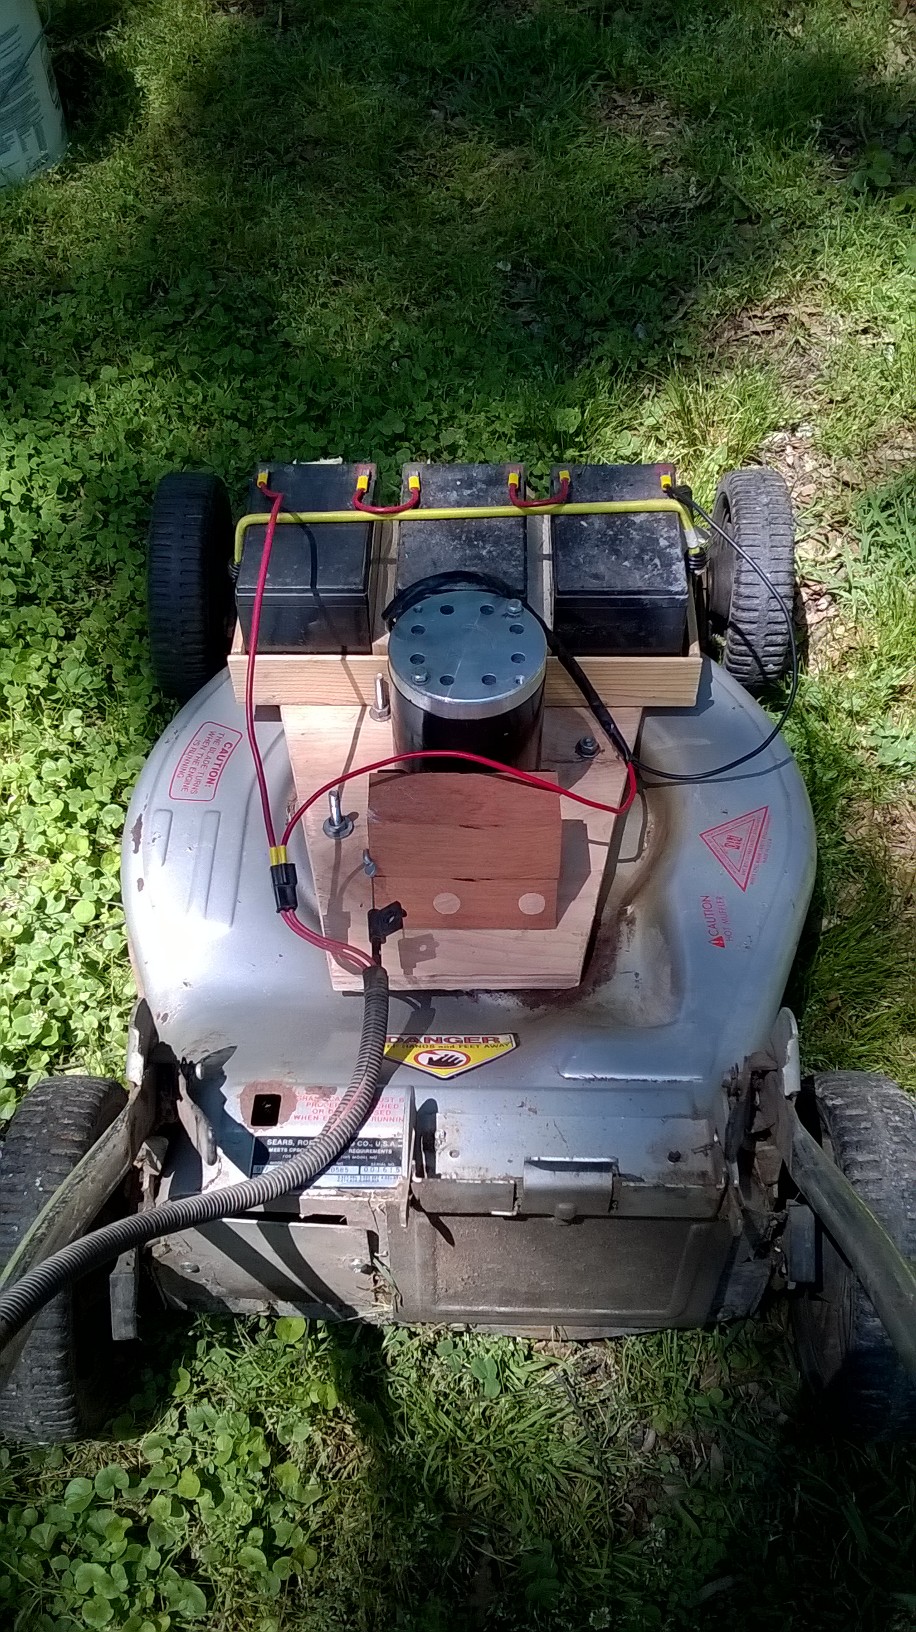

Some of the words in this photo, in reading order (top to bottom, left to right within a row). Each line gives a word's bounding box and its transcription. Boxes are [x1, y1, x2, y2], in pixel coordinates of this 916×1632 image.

[199, 730, 216, 752] WHEN
[212, 732, 225, 746] THE
[176, 747, 197, 778] RUNNING
[192, 752, 204, 766] THE
[201, 747, 217, 769] BLADE
[205, 742, 233, 787] CAUTION:
[180, 767, 197, 792] ENGINE
[190, 771, 204, 795] TURNS
[700, 895, 719, 937] CAUTION
[723, 927, 733, 942] HOT
[386, 1036, 500, 1044] DANGER
[266, 1138, 295, 1146] SEARS,
